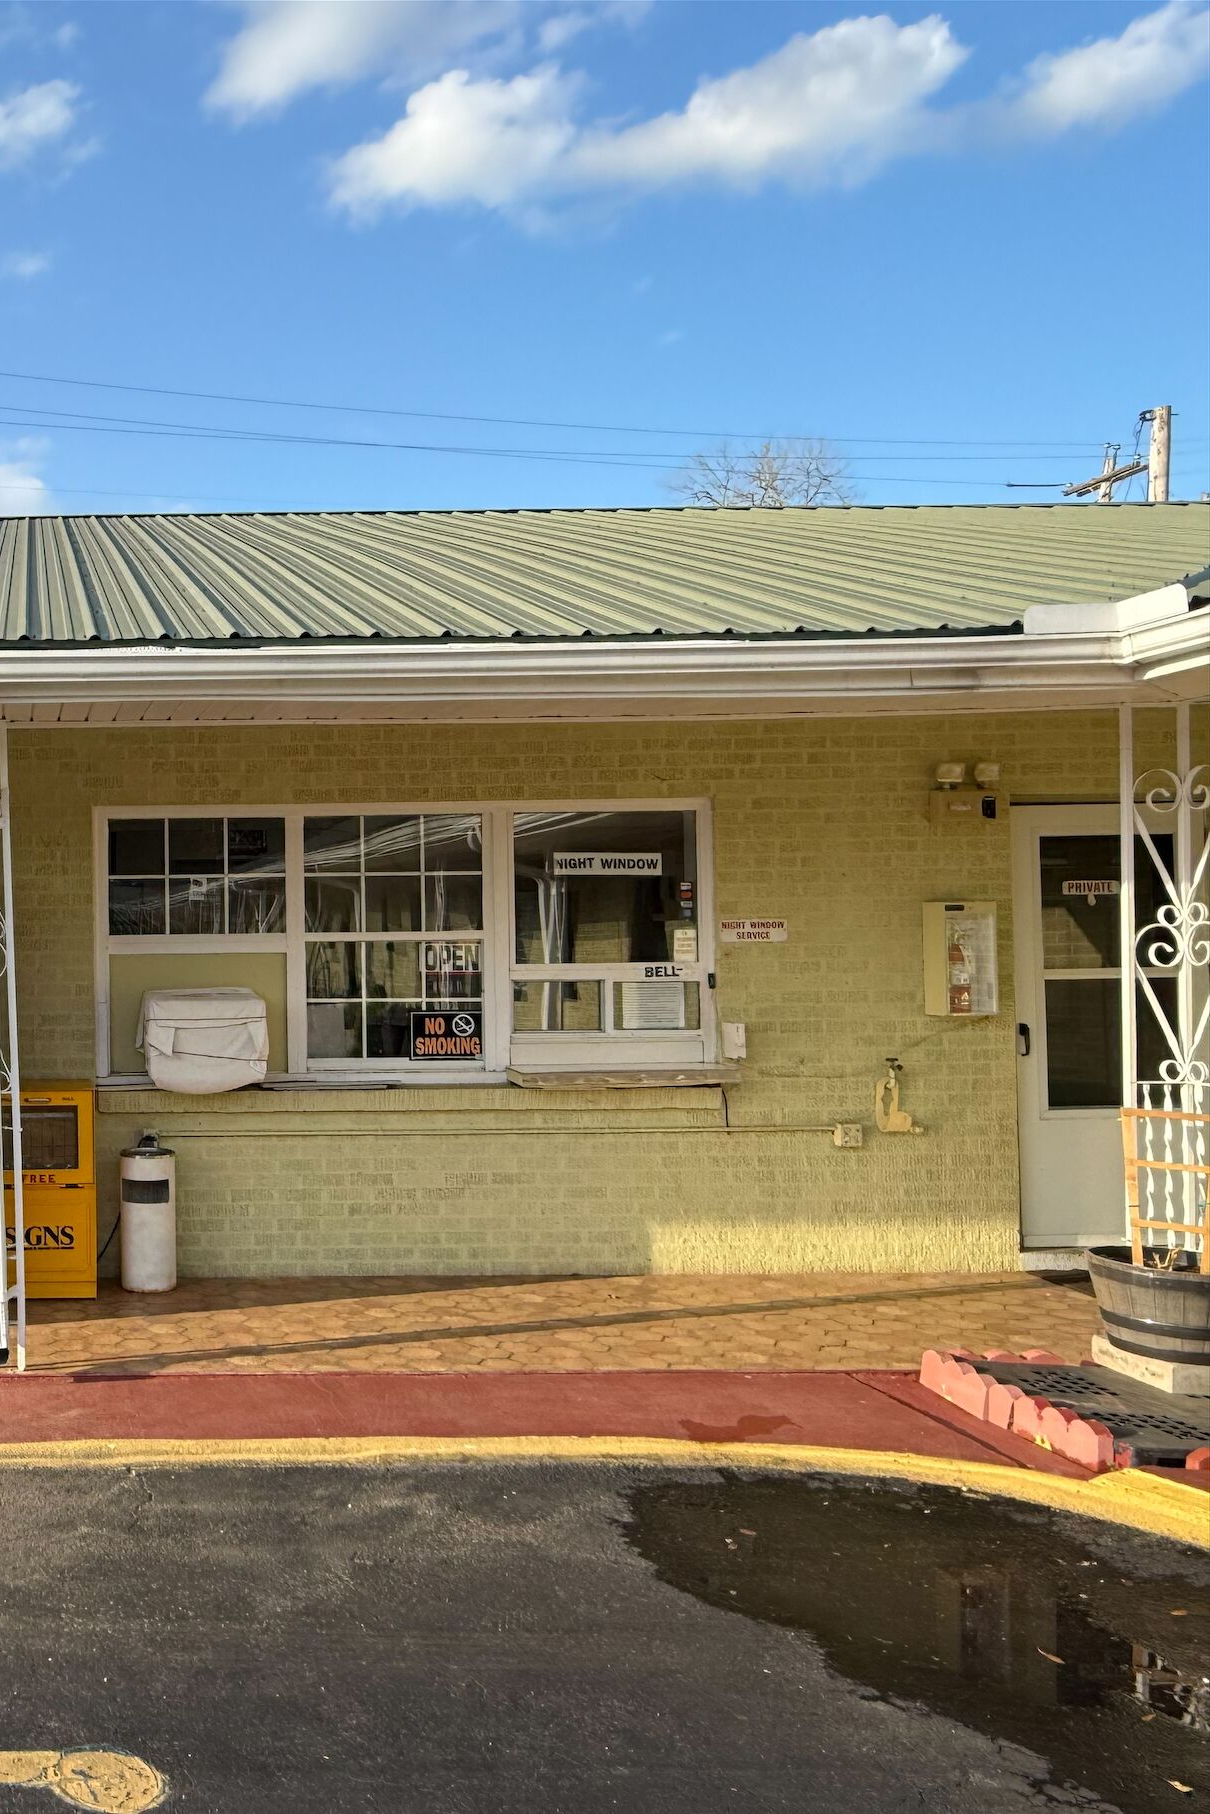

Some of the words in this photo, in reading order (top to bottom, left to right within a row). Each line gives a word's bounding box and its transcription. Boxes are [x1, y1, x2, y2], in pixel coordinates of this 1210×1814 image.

[557, 857, 595, 870] NIGHT
[600, 858, 659, 870] WINDOW
[1067, 881, 1115, 894] PRIVATE
[721, 921, 747, 930] NIGHT
[750, 921, 785, 929] WINDOW
[736, 931, 771, 940] SERVICE
[425, 944, 480, 972] OPEN
[424, 1017, 446, 1036] NO
[414, 1036, 482, 1056] SMOKING
[21, 1174, 57, 1184] FREE
